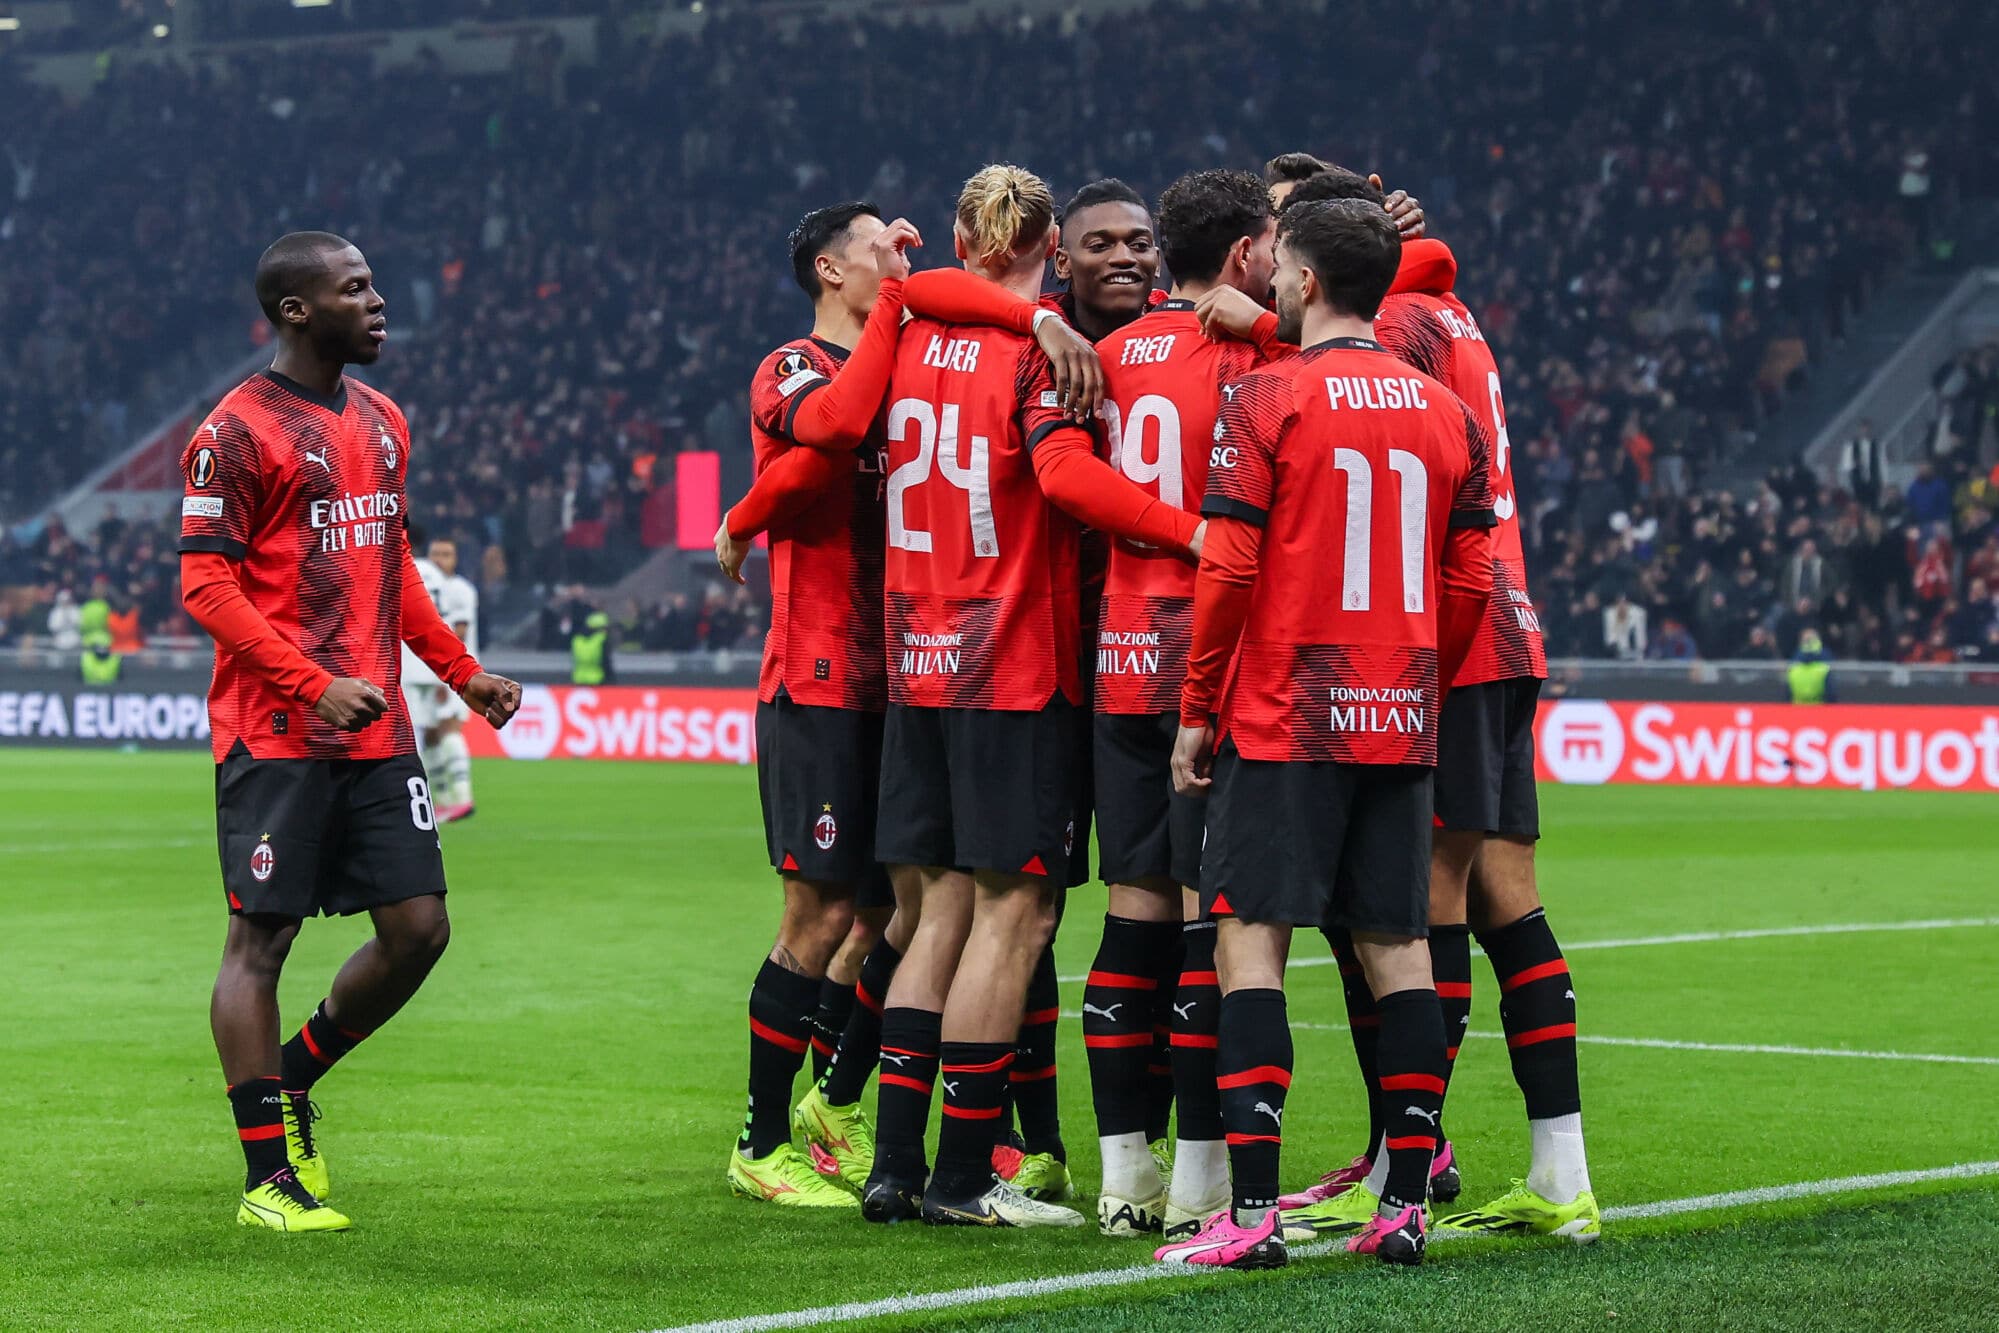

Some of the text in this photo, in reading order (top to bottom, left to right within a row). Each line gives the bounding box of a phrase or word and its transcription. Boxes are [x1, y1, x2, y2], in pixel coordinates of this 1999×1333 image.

[1120, 334, 1176, 366] THEO
[1325, 376, 1428, 411] PULISIC
[887, 397, 1000, 558] 24
[322, 526, 347, 553] FLY
[1333, 447, 1428, 614] 11
[900, 649, 960, 675] MILAN
[1096, 649, 1160, 674] MILAN
[1330, 687, 1424, 702] FONDAZIONE
[1330, 706, 1424, 733] MILAN
[1631, 703, 1999, 791] Swissquot
